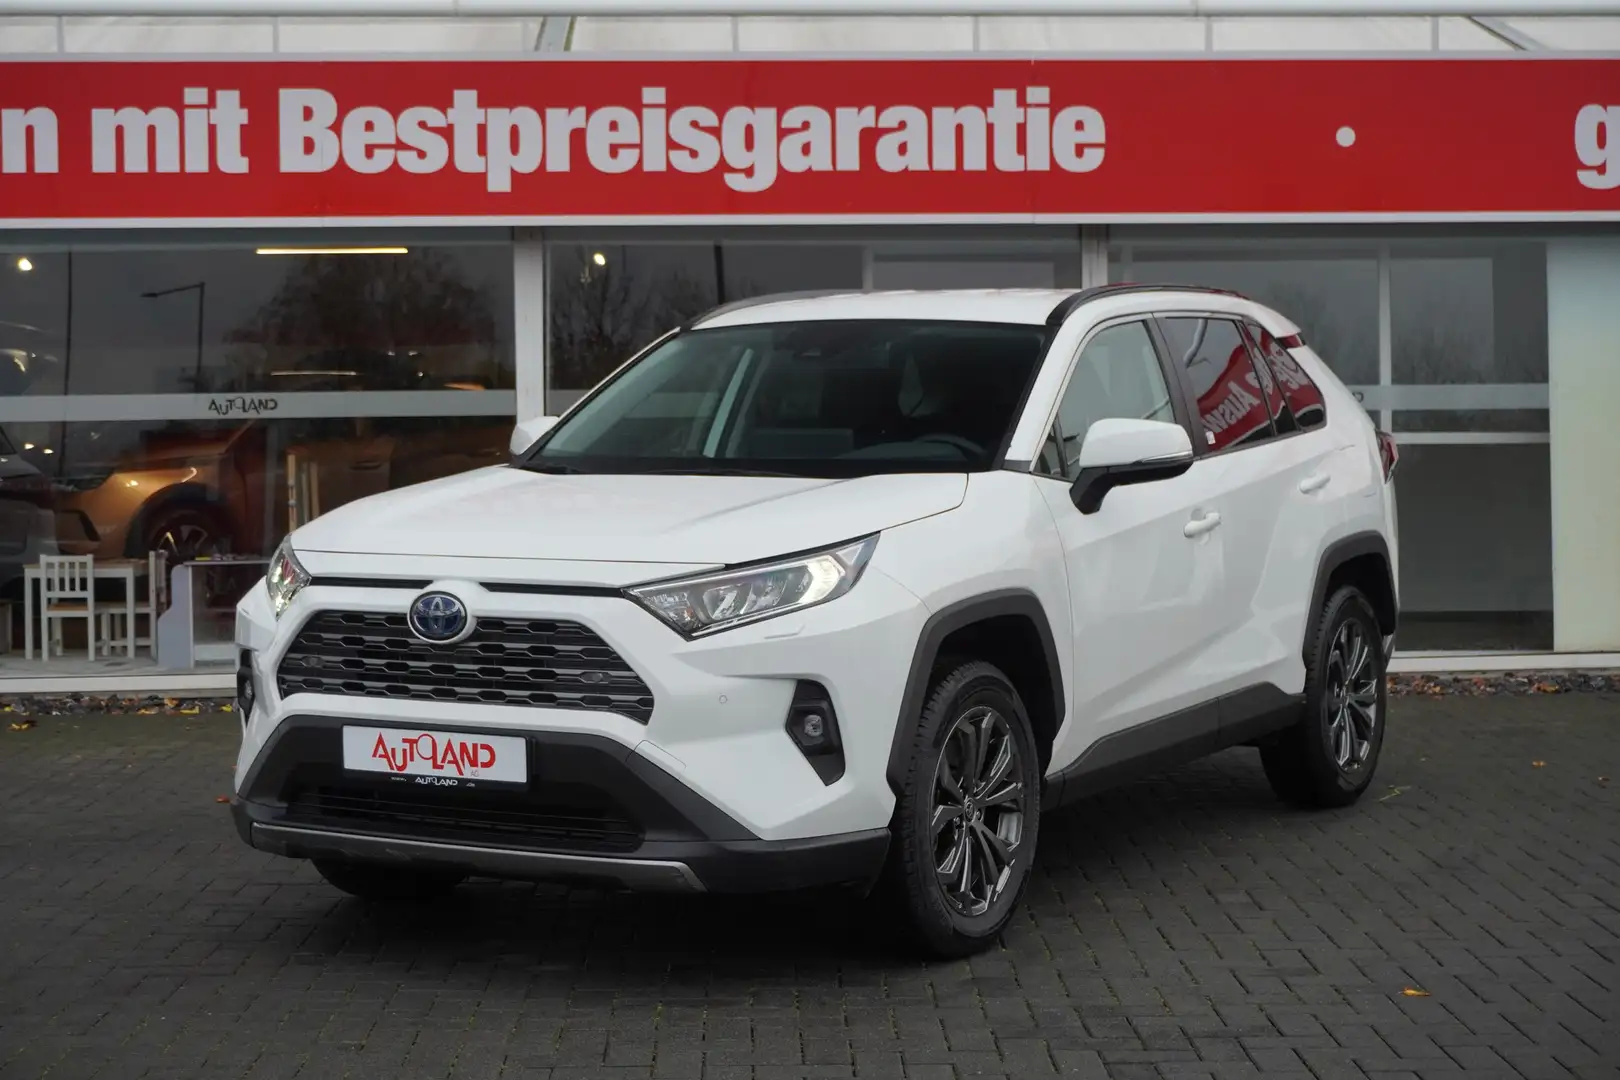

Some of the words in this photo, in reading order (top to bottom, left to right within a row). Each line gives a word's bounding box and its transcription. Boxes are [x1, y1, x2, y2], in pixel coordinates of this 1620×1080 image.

[91, 87, 249, 174] mit
[278, 87, 1106, 193] Bestpreisgarantie
[1574, 104, 1620, 190] g
[208, 396, 278, 415] AUTOLAND
[372, 732, 496, 776] AUTOLAND
[415, 776, 458, 786] AUTOLAND
